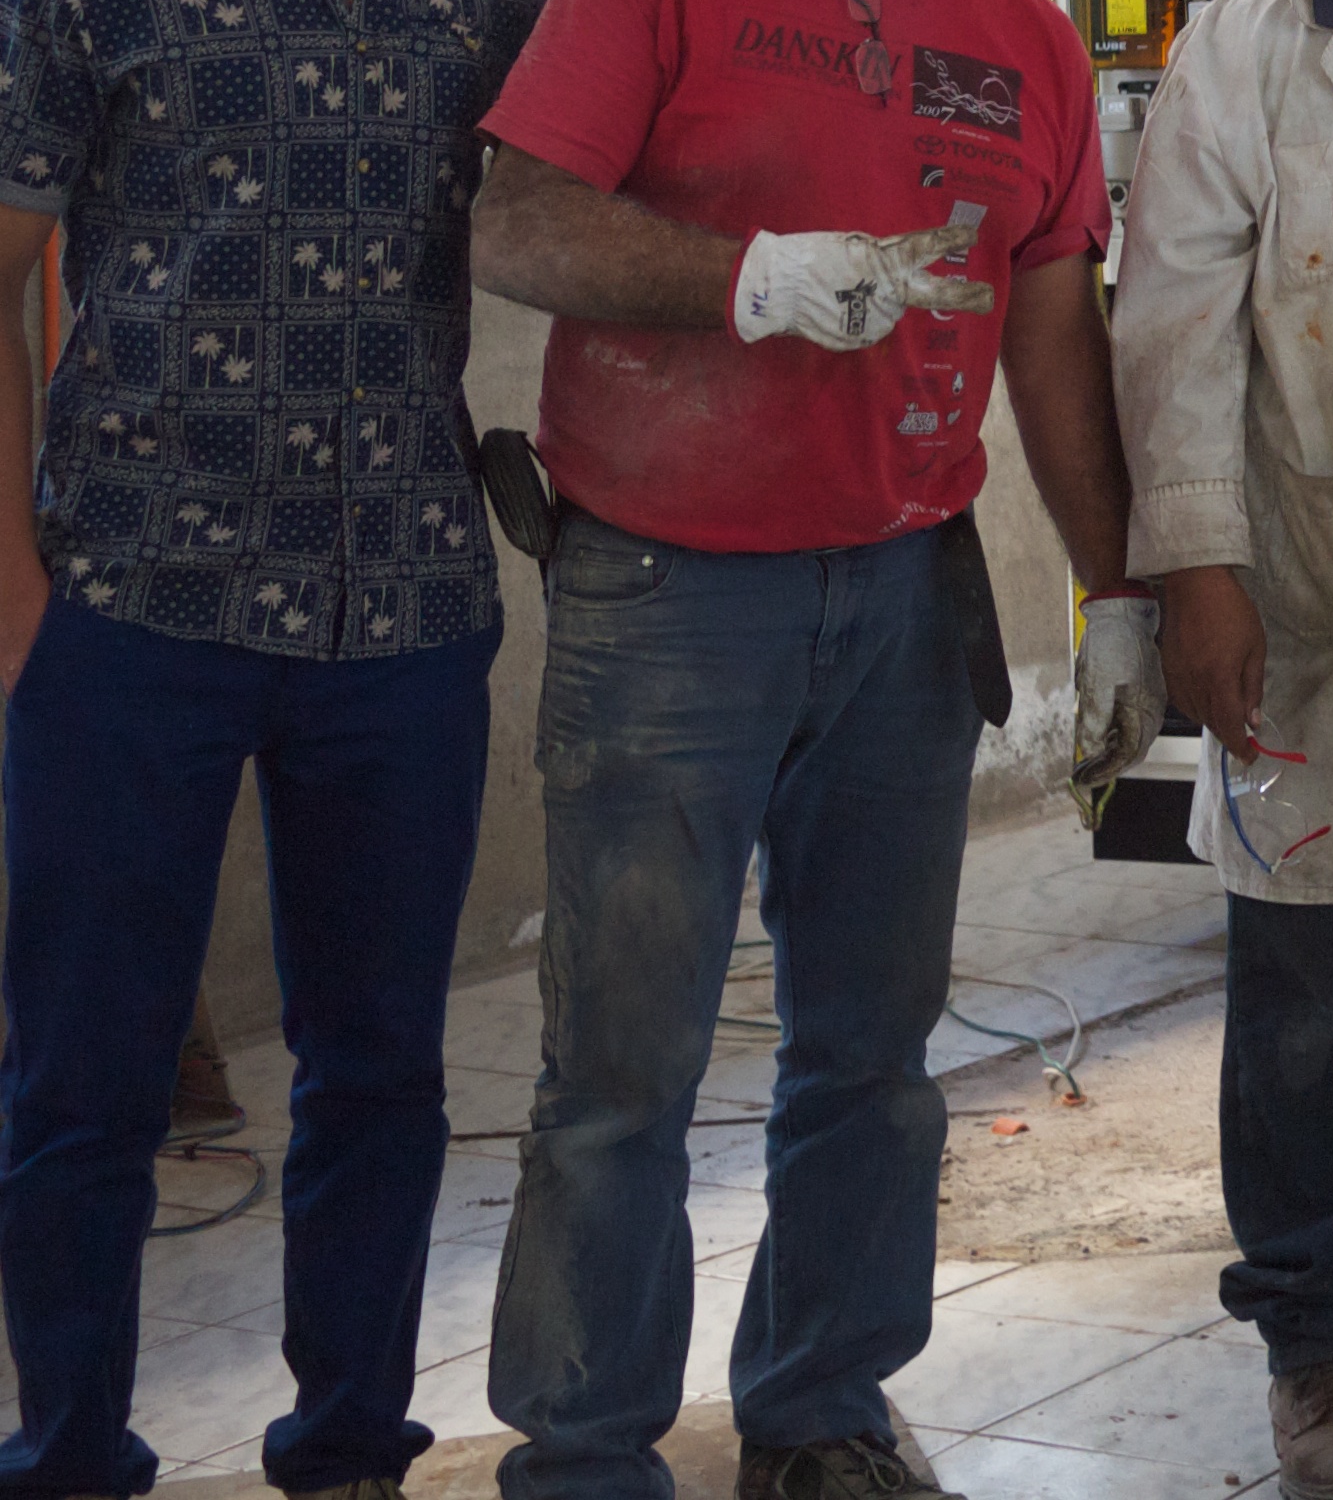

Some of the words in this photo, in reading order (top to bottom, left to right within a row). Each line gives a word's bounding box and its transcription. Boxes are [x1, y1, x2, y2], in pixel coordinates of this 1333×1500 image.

[734, 17, 902, 84] DANSKIN
[1095, 40, 1127, 51] LUBE
[914, 102, 956, 126] 2007
[950, 140, 1023, 172] TOYOTA
